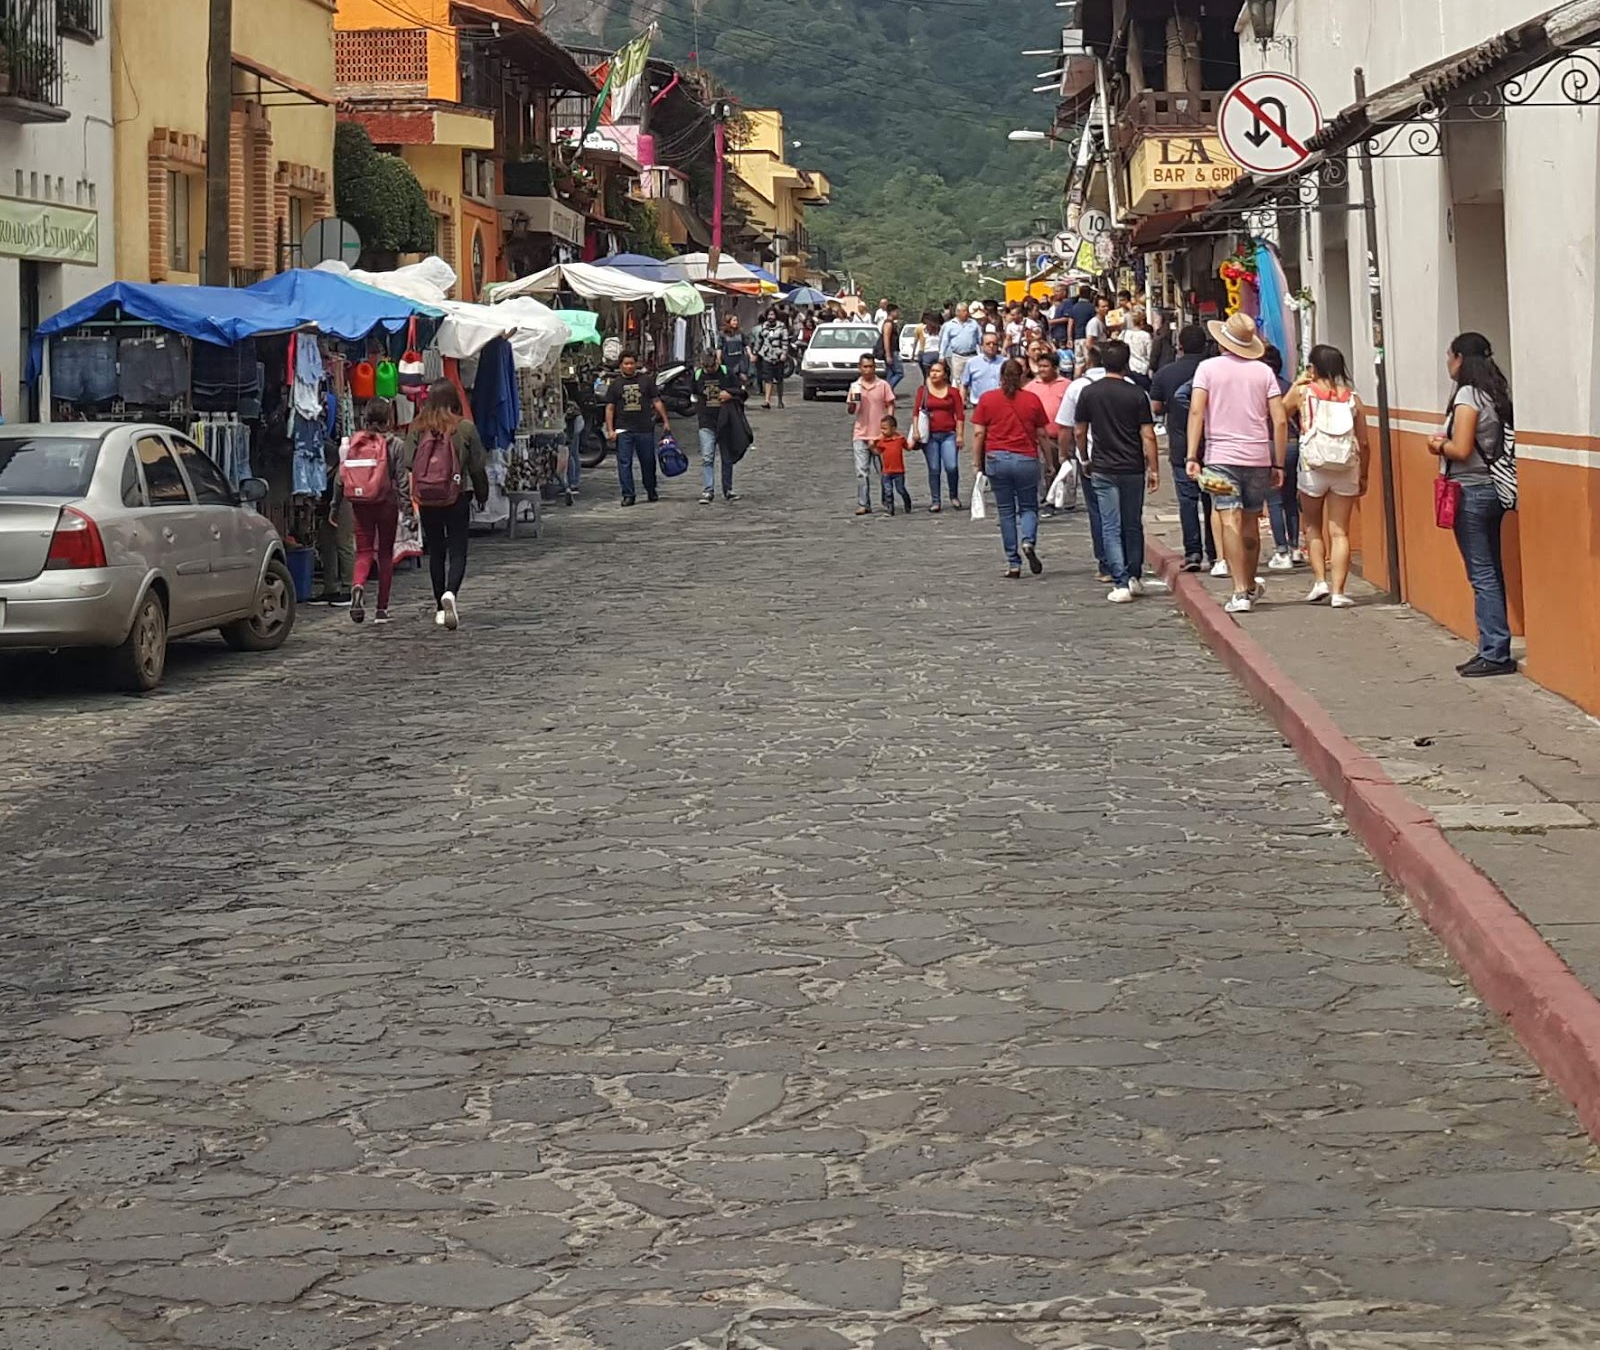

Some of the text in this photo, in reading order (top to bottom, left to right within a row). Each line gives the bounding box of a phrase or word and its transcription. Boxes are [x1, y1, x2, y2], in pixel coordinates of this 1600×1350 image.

[1158, 139, 1214, 165] LA
[1153, 168, 1185, 182] BAR
[1195, 168, 1205, 182] &
[1089, 215, 1105, 232] 10
